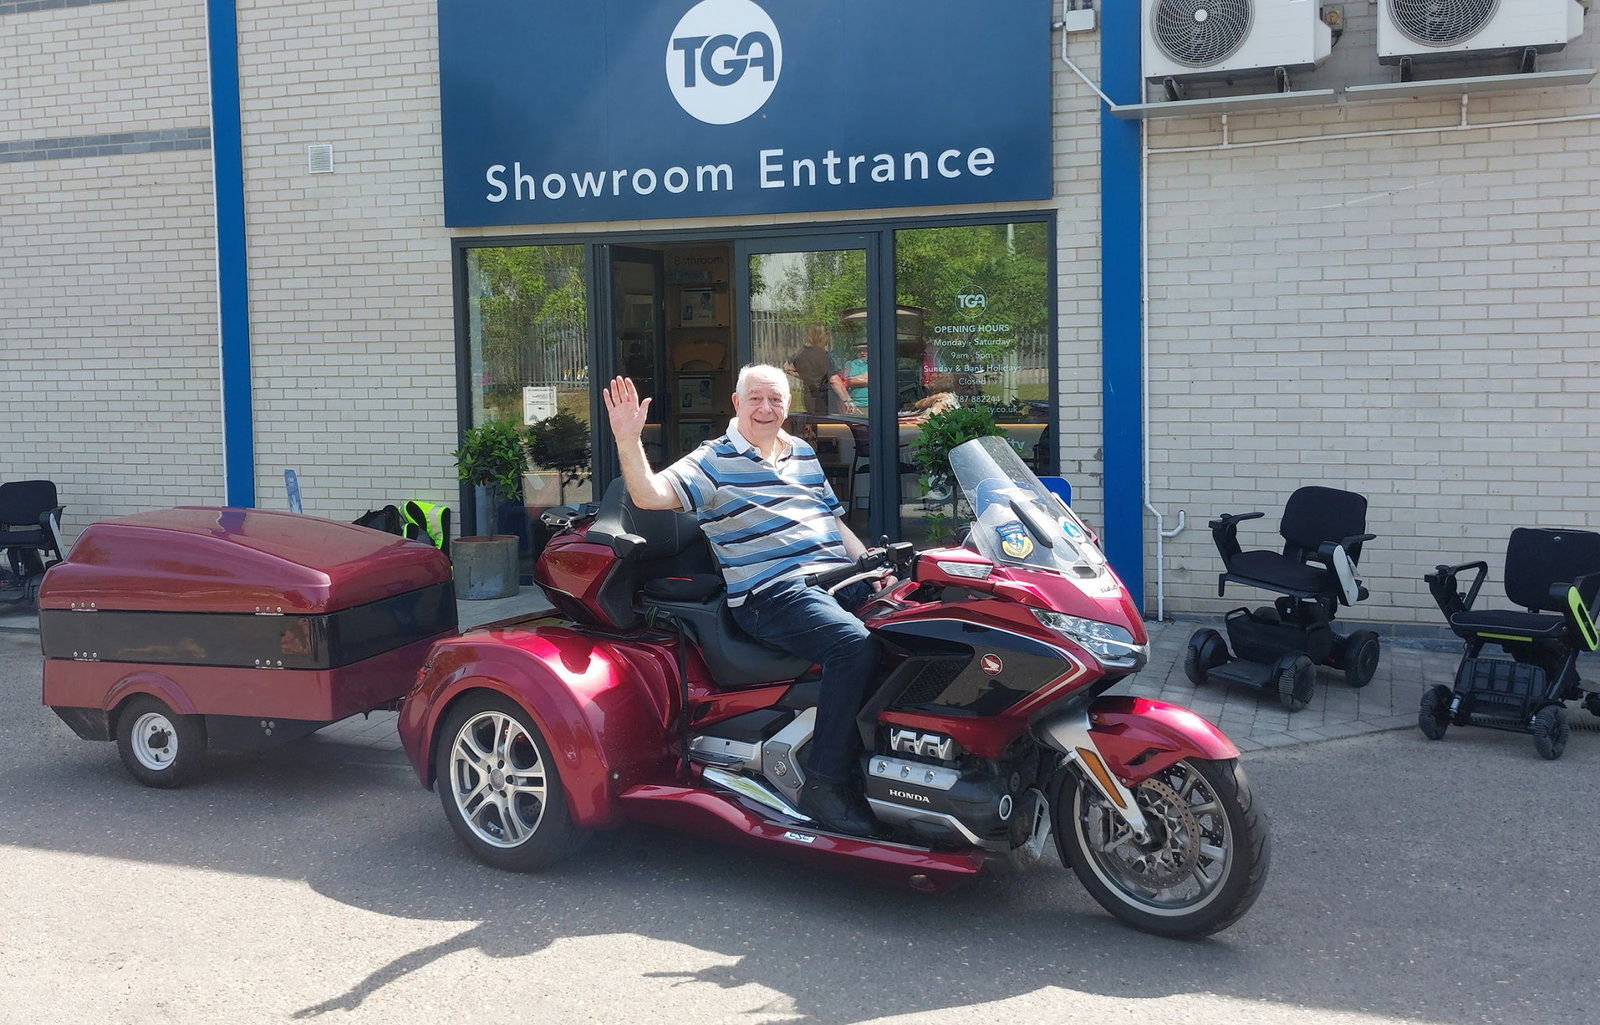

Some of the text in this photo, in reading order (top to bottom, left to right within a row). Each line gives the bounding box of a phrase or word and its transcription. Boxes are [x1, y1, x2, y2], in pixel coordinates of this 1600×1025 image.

[673, 31, 775, 89] TGA
[486, 146, 996, 204] Showroom Entrance
[674, 255, 724, 266] Bathroom
[957, 293, 986, 309] TGA
[934, 324, 1010, 334] OPENING HOURS
[933, 339, 967, 348] Monday
[974, 337, 1011, 347] Saturday
[951, 352, 968, 360] 9am
[923, 364, 953, 374] Sunday
[964, 363, 984, 373] Bank
[958, 377, 987, 386] Closed
[971, 395, 1001, 403] 882244
[889, 789, 932, 804] HONDA
